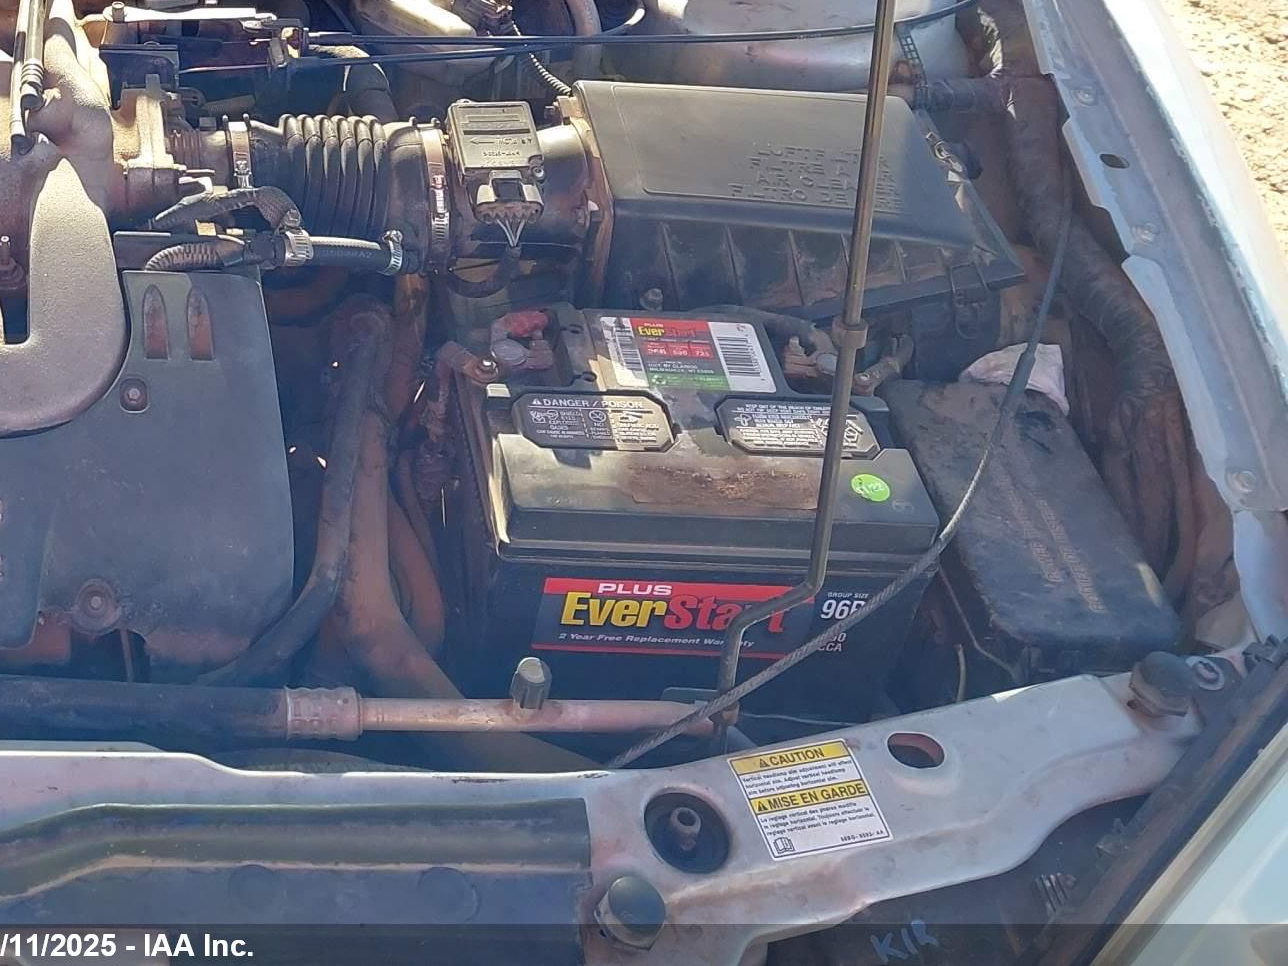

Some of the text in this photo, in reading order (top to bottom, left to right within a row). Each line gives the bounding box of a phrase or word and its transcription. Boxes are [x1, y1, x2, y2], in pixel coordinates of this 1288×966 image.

[543, 398, 590, 407] DANGER
[602, 400, 644, 409] POISON
[598, 583, 673, 596] PLUS
[561, 591, 786, 633] EverStat
[597, 634, 623, 642] Free
[625, 635, 702, 646] Replacement
[769, 748, 824, 765] CAUTION
[768, 784, 865, 808] MISE EN GARDE
